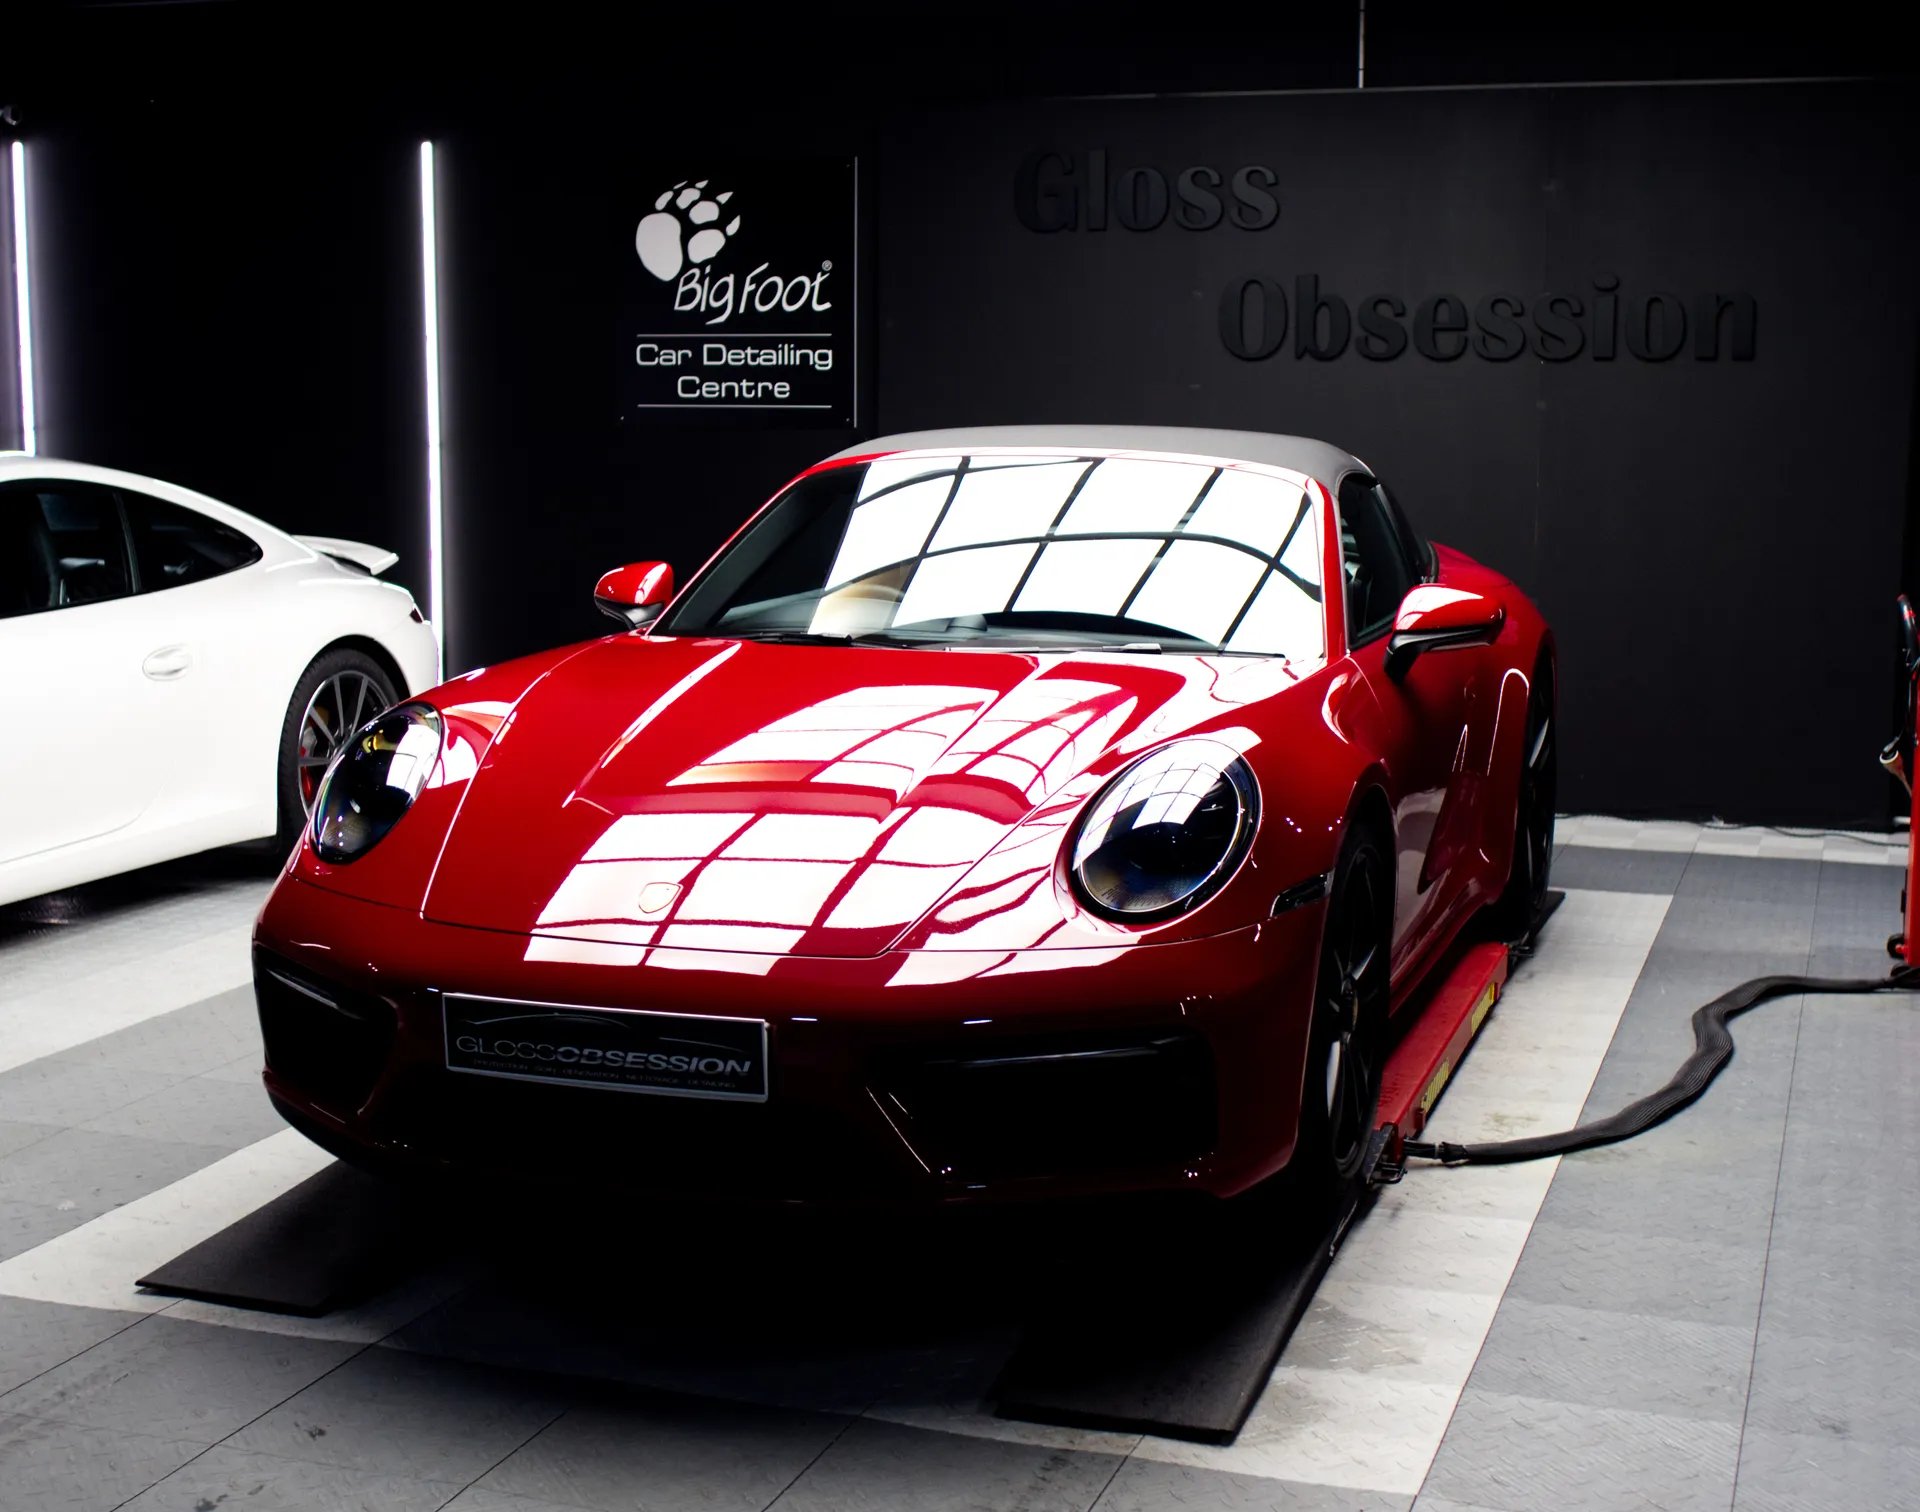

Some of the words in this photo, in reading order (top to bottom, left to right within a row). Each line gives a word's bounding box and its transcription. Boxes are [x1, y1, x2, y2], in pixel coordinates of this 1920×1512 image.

[1014, 148, 1280, 232] Gloss
[1219, 273, 1757, 362] Obsession
[636, 343, 692, 367] Car
[702, 343, 833, 371] Detailing
[676, 375, 791, 399] Centre
